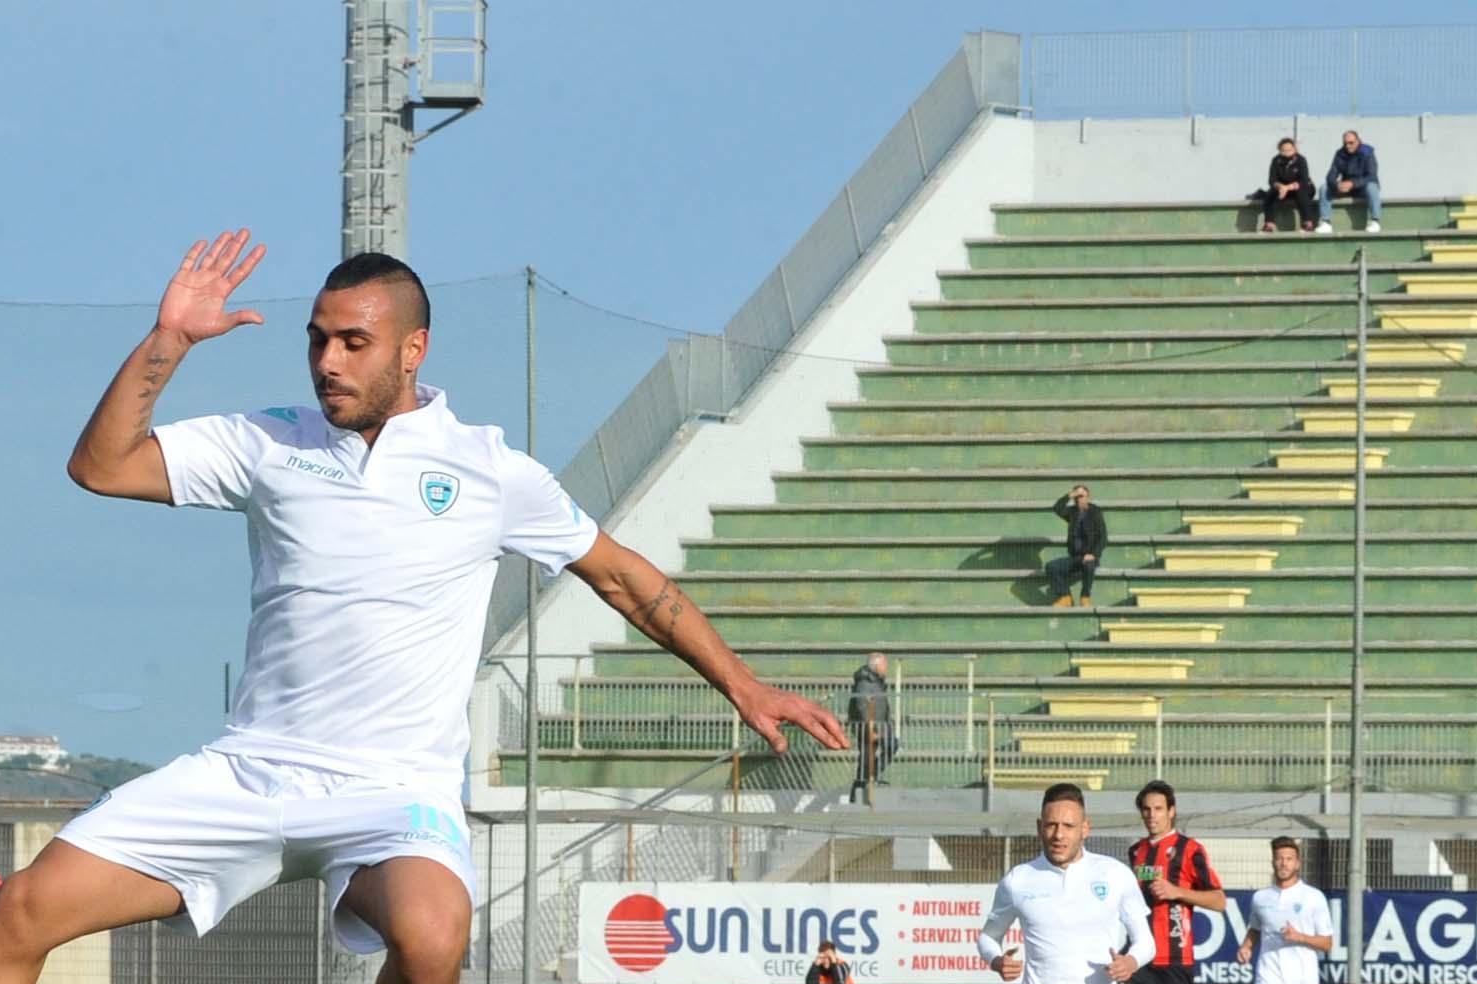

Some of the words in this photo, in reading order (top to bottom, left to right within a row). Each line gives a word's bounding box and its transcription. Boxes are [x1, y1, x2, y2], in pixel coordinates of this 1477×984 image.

[285, 455, 345, 481] macron
[912, 901, 982, 916] AUTOLINEE
[663, 907, 749, 954] SUN
[912, 928, 961, 943] SERVIZI
[764, 960, 804, 977] ELITE
